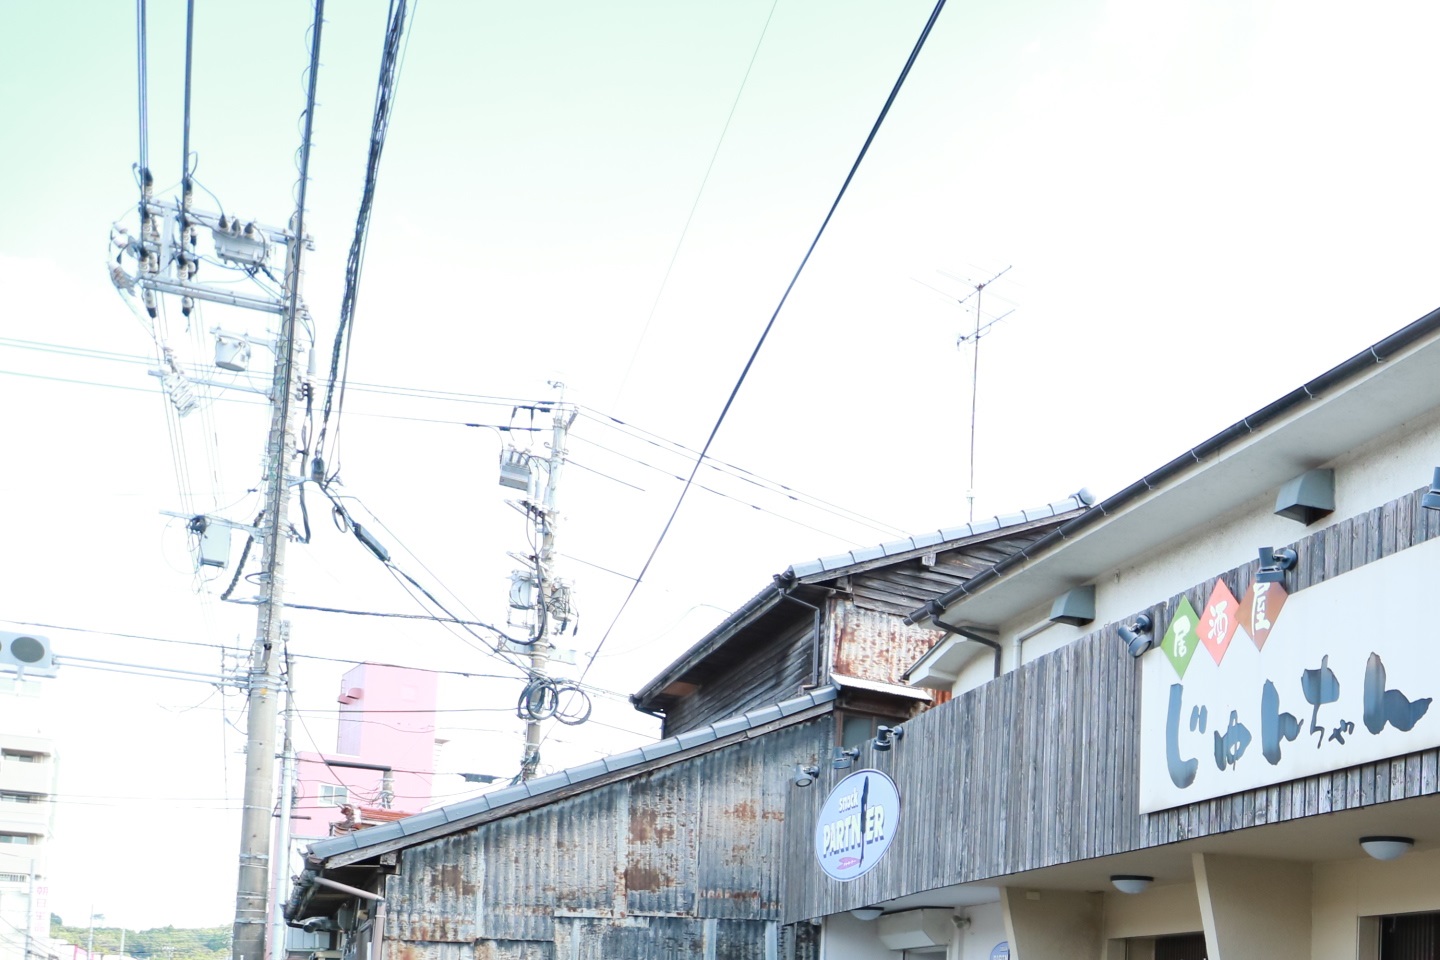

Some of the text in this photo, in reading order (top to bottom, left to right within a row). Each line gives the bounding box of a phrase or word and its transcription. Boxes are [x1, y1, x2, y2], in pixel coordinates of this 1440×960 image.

[1172, 582, 1271, 658] 居酒屋
[1165, 652, 1433, 789] じゅんちゃん
[823, 805, 885, 857] PARTNER
